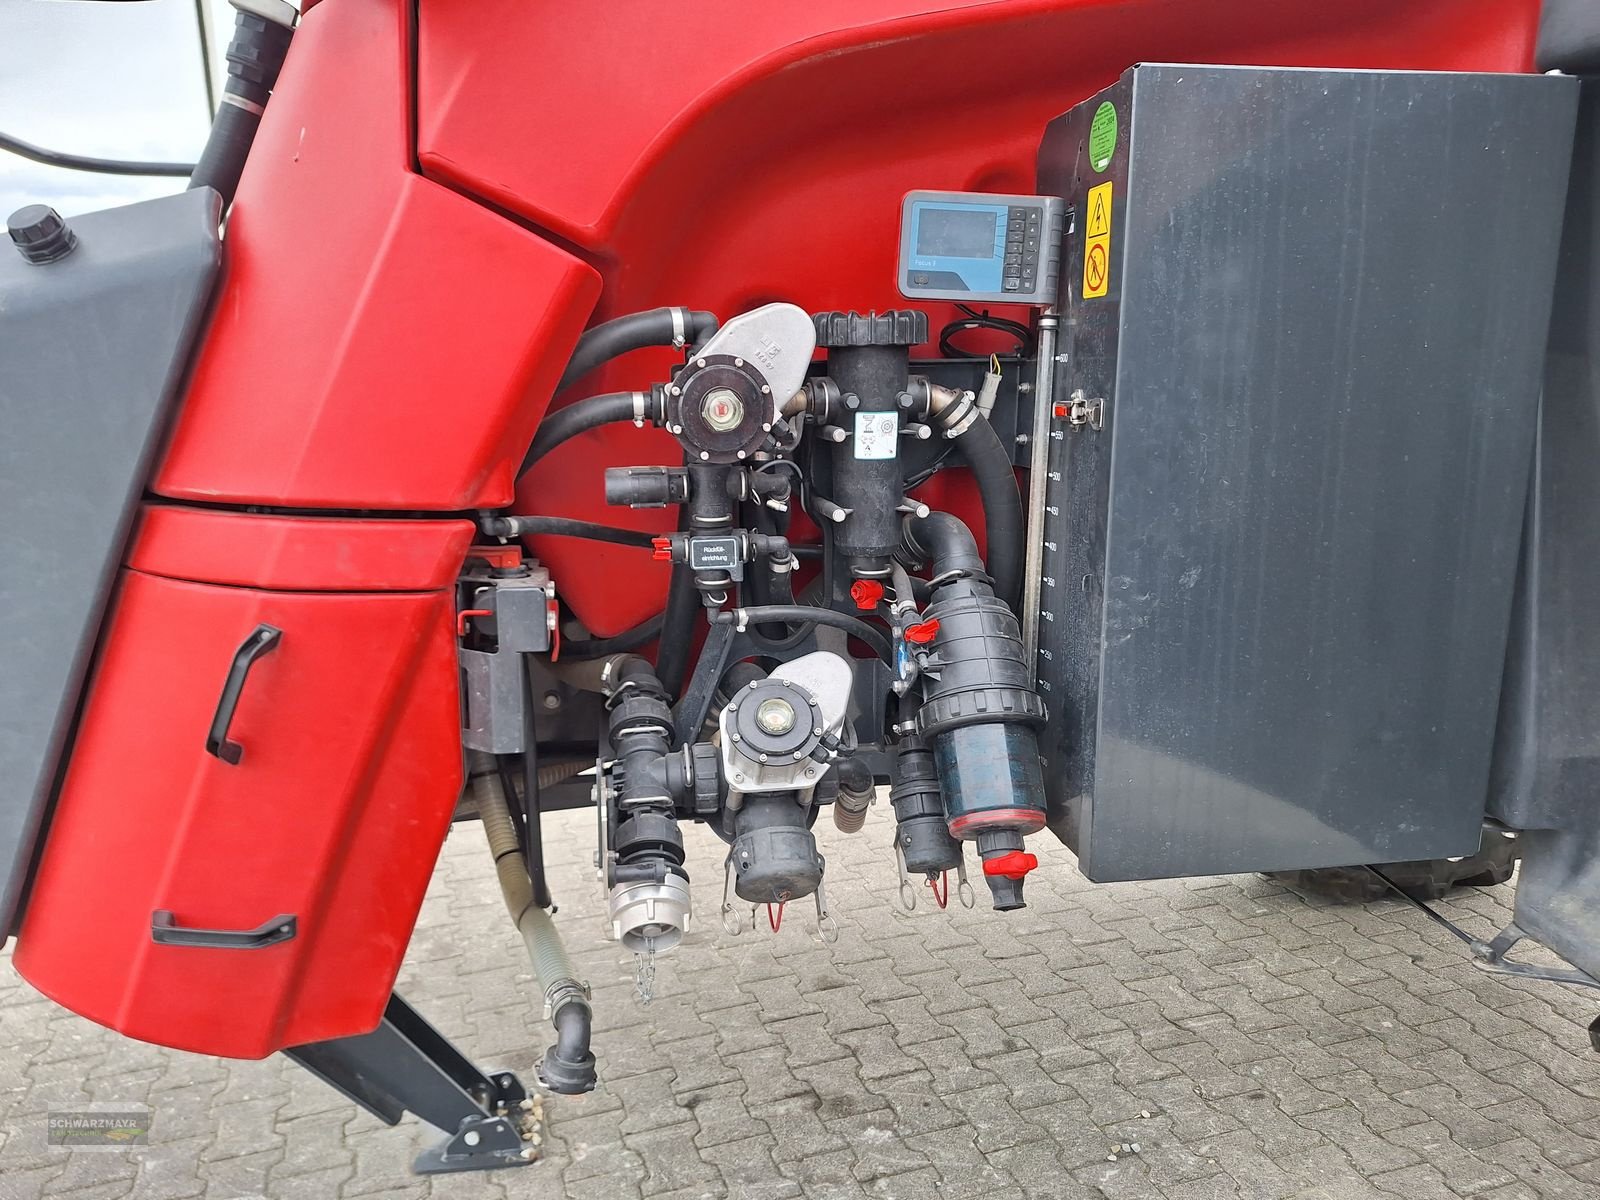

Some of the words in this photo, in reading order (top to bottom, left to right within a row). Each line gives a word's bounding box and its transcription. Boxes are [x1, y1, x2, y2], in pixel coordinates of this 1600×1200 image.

[1060, 353, 1068, 363] 600
[1055, 431, 1063, 440] 550
[1052, 472, 1061, 481] 500
[1050, 506, 1059, 516] 450
[1048, 542, 1057, 552] 400
[702, 554, 728, 562] einrichtung
[1047, 577, 1055, 587] 350
[1046, 611, 1054, 623] 300
[1044, 650, 1052, 661] 250
